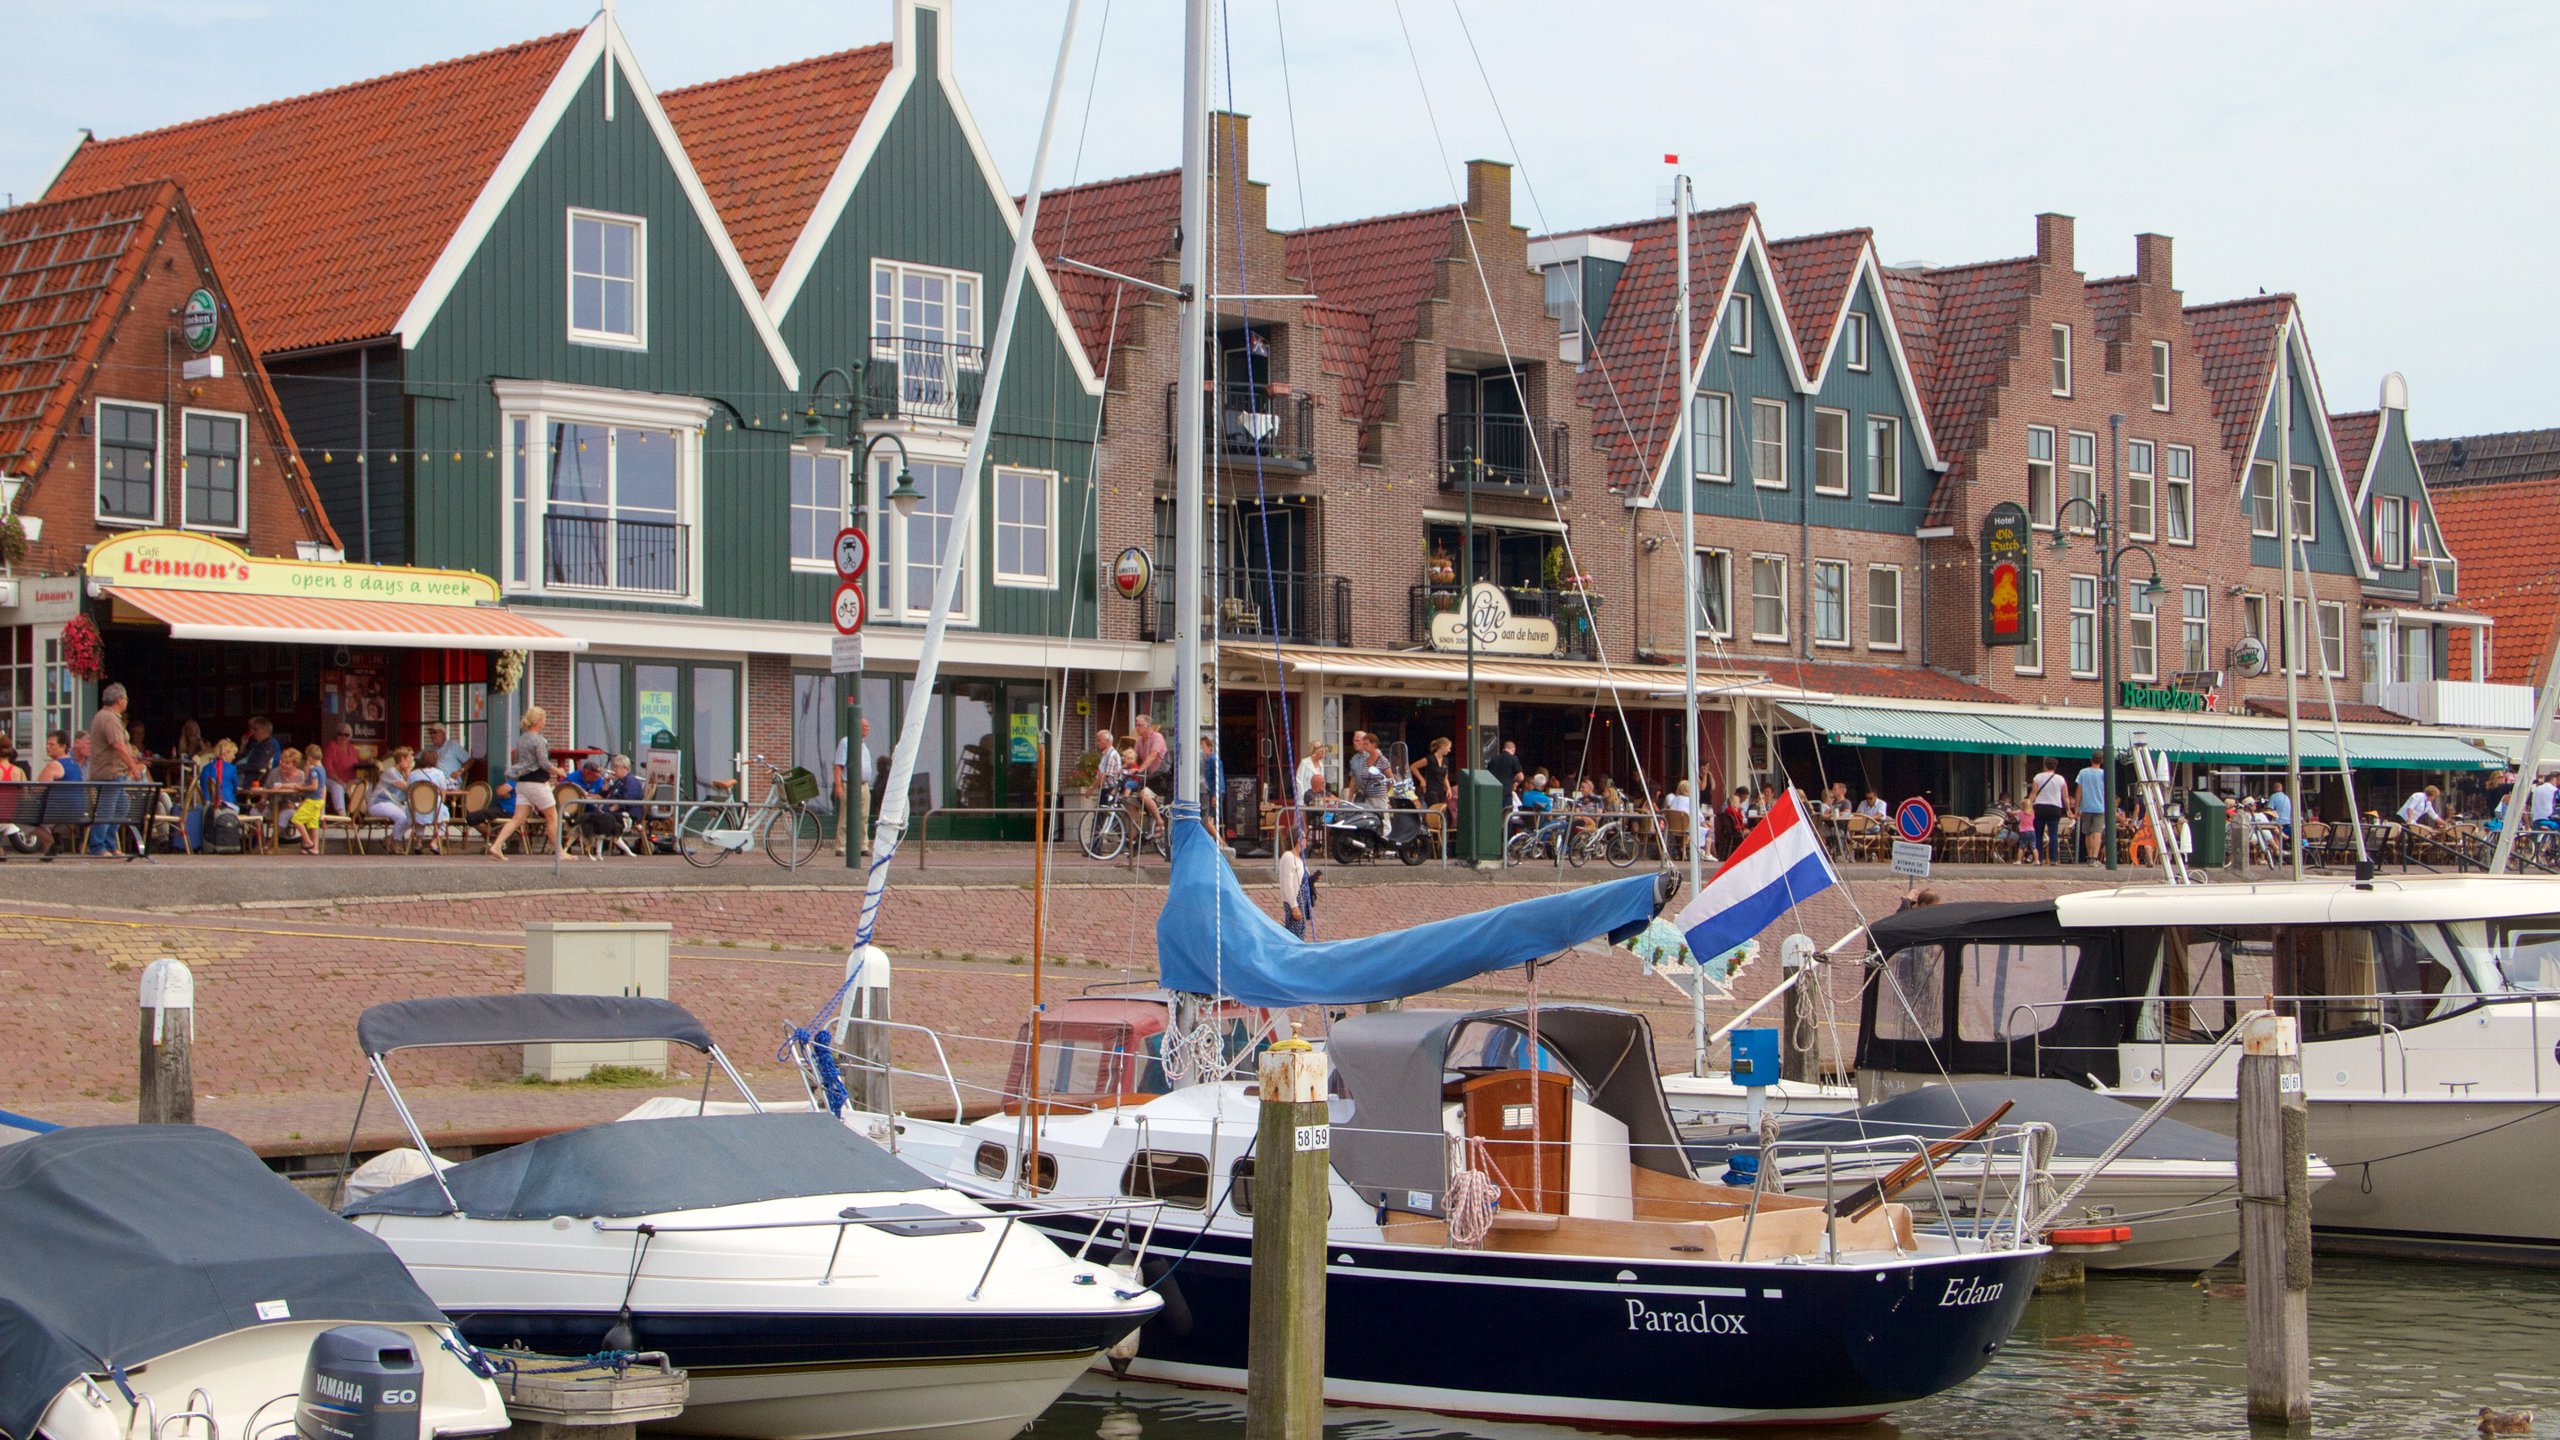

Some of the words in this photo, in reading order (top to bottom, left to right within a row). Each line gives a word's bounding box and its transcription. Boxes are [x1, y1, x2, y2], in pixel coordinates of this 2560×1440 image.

[1994, 516, 2015, 526] Hotel
[1995, 528, 2014, 540] Old
[137, 545, 160, 557] Café
[1990, 539, 2019, 552] Dutch
[124, 551, 250, 581] Lennon's
[291, 573, 337, 589] open
[343, 575, 353, 588] 8
[360, 574, 404, 595] days
[410, 580, 421, 593] a
[428, 580, 471, 596] week
[1452, 590, 1506, 650] Lotje
[1501, 630, 1515, 640] aan
[1516, 628, 1526, 640] de
[1528, 628, 1549, 642] haven
[649, 693, 662, 703] TE
[2123, 681, 2201, 711] Heineken
[641, 704, 671, 715] HUUR
[1019, 716, 1028, 725] TE
[1298, 1130, 1310, 1147] 58
[1315, 1128, 1327, 1145] 59
[1938, 1275, 2003, 1306] Edam
[1625, 1298, 1749, 1335] Paradox
[316, 1373, 363, 1404] YAMAHA
[382, 1389, 417, 1405] 60
